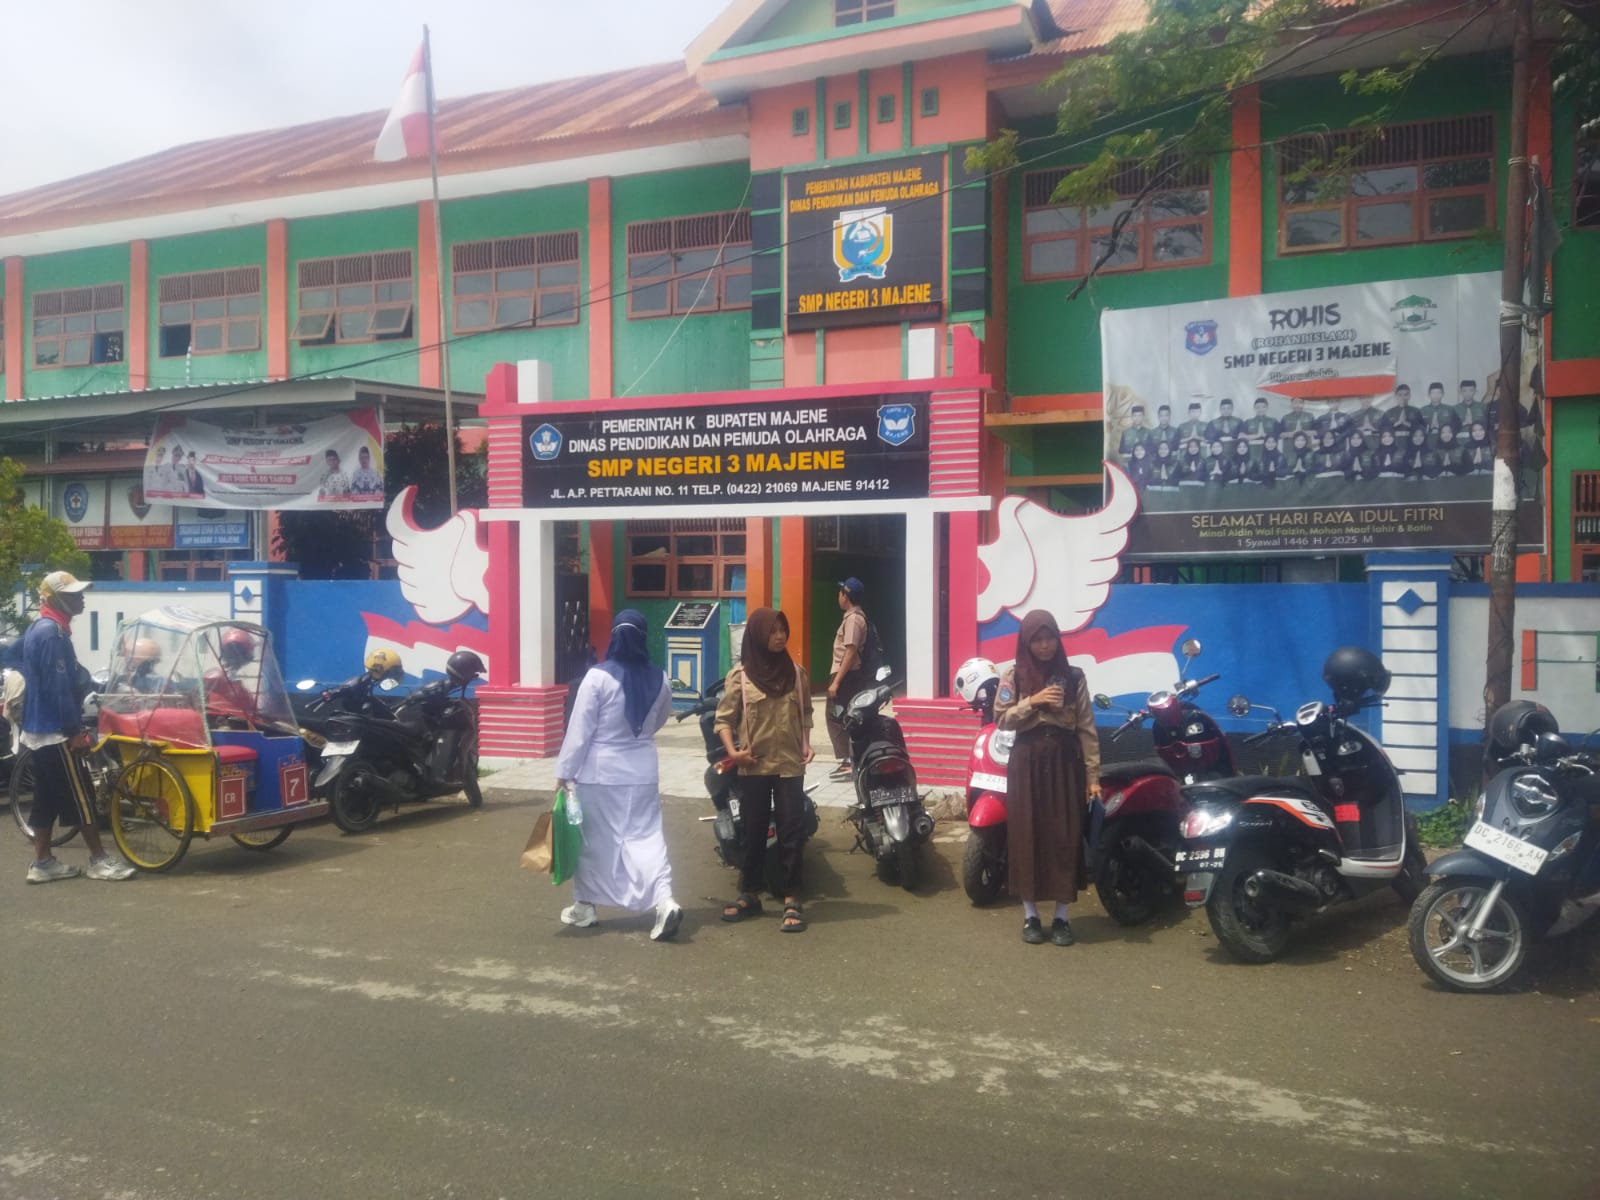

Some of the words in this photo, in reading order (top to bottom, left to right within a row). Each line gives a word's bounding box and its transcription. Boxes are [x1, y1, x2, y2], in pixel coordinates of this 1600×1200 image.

[805, 177, 849, 195] PEMERINTAH
[849, 171, 891, 190] KABUPATEN
[892, 167, 922, 184] MAJENE
[790, 197, 810, 213] DINAS
[855, 190, 869, 205] DAN
[871, 186, 899, 203] PEMUDA
[798, 293, 823, 313] SMP
[825, 289, 869, 311] NEGERI
[871, 289, 878, 307] 3
[881, 283, 931, 306] MAJENE
[1268, 303, 1341, 331] ROHIS
[1223, 353, 1255, 369] SMP
[1258, 349, 1311, 366] NEGERI
[1315, 347, 1324, 361] 3
[1328, 342, 1391, 360] MAJENE
[602, 416, 682, 434] PEMERINTAH
[706, 411, 767, 429] BUPATEN
[770, 408, 828, 425] MAJENE
[569, 438, 606, 453] DINAS
[610, 435, 689, 451] PENDIDIKAN
[693, 434, 721, 448] DAN
[724, 431, 781, 447] PEMUDA
[785, 426, 867, 443] OLAHRAGA
[588, 458, 633, 478] SMP
[637, 455, 721, 476] NEGERI
[727, 454, 739, 473] 3
[746, 450, 845, 472] MAJENE
[550, 488, 565, 499] JL.
[567, 488, 587, 499] A.P.
[590, 486, 651, 498] PETTARANI
[655, 486, 674, 496] NO.
[678, 485, 688, 495] 11
[692, 484, 723, 495] TELP.
[727, 482, 761, 496] (0422)
[765, 482, 797, 493] 21069
[802, 480, 851, 492] MAJENE
[855, 479, 889, 490] 91412
[1192, 513, 1264, 528] SELAMAT
[1270, 511, 1307, 525] HARI
[1313, 510, 1354, 524] RAYA
[1360, 509, 1399, 523] IDUL
[1404, 507, 1444, 521] FITRI
[1199, 529, 1226, 538] Minal
[1256, 527, 1274, 536] Wal
[1310, 526, 1342, 535] Mohon
[1344, 525, 1370, 534] Maaf
[1397, 525, 1404, 533] &
[1407, 524, 1432, 532] Batin
[1246, 537, 1281, 548] Syawal
[1284, 537, 1309, 545] 1446
[1313, 536, 1321, 545] H
[1330, 535, 1358, 545] 2025
[1362, 535, 1374, 544] M
[289, 778, 299, 797] 7
